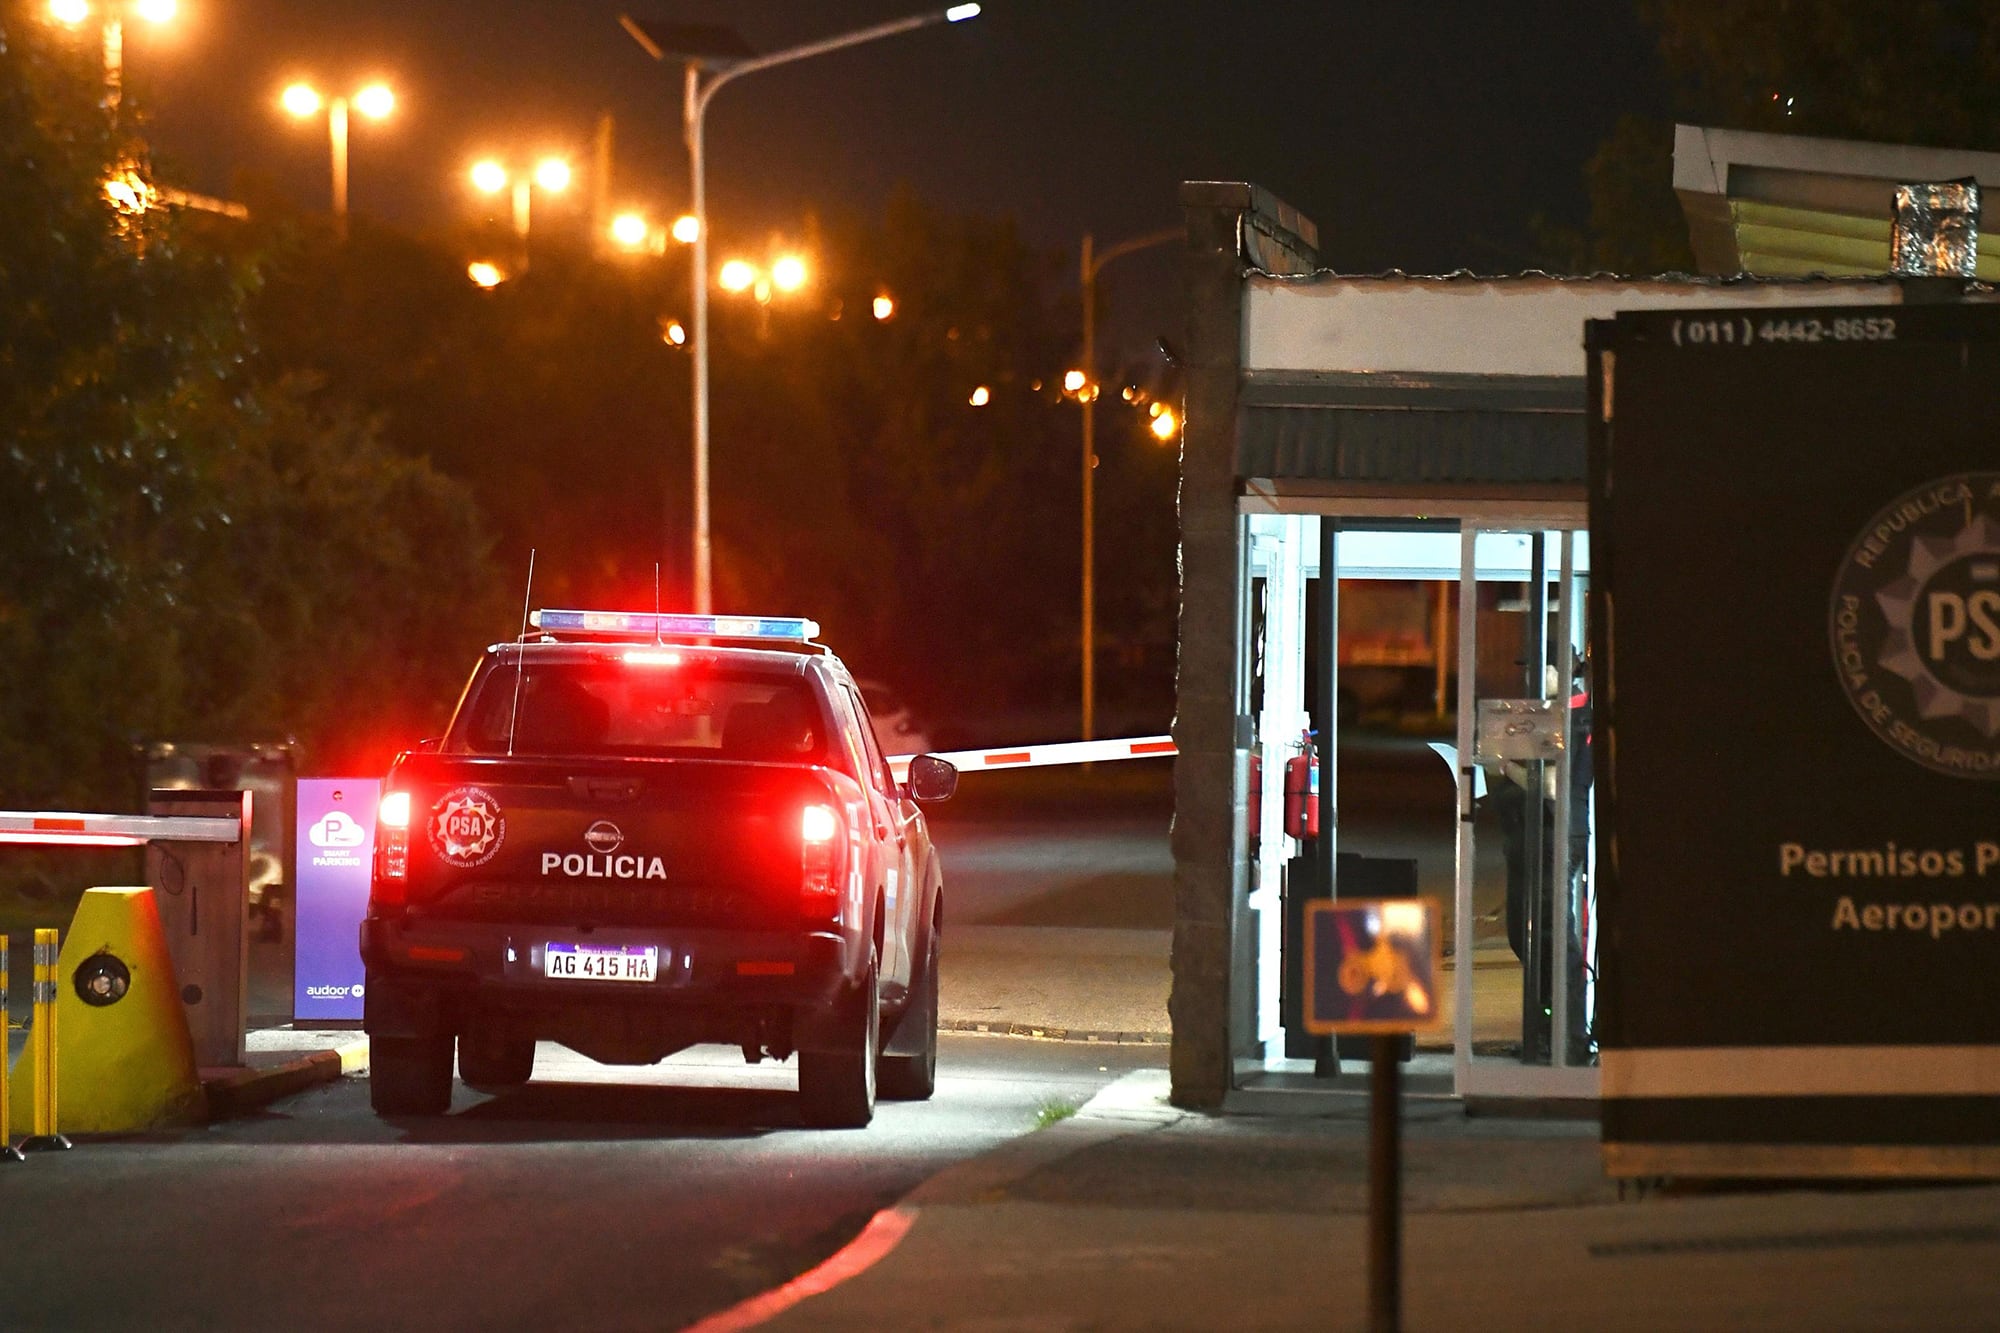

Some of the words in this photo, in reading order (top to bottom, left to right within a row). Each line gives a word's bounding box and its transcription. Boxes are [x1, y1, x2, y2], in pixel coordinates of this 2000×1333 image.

[1758, 318, 1897, 342] 4442-8652
[1838, 594, 1868, 689] POLICIA
[1860, 690, 1892, 725] DE
[450, 816, 481, 836] PSA
[312, 857, 361, 867] PARKING
[541, 852, 668, 880] POLICIA
[1779, 841, 1965, 877] Permisos
[1831, 896, 2000, 939] Aeropor
[552, 955, 576, 974] AG
[583, 956, 619, 976] 415
[626, 958, 650, 978] HA
[306, 984, 350, 996] audoor
